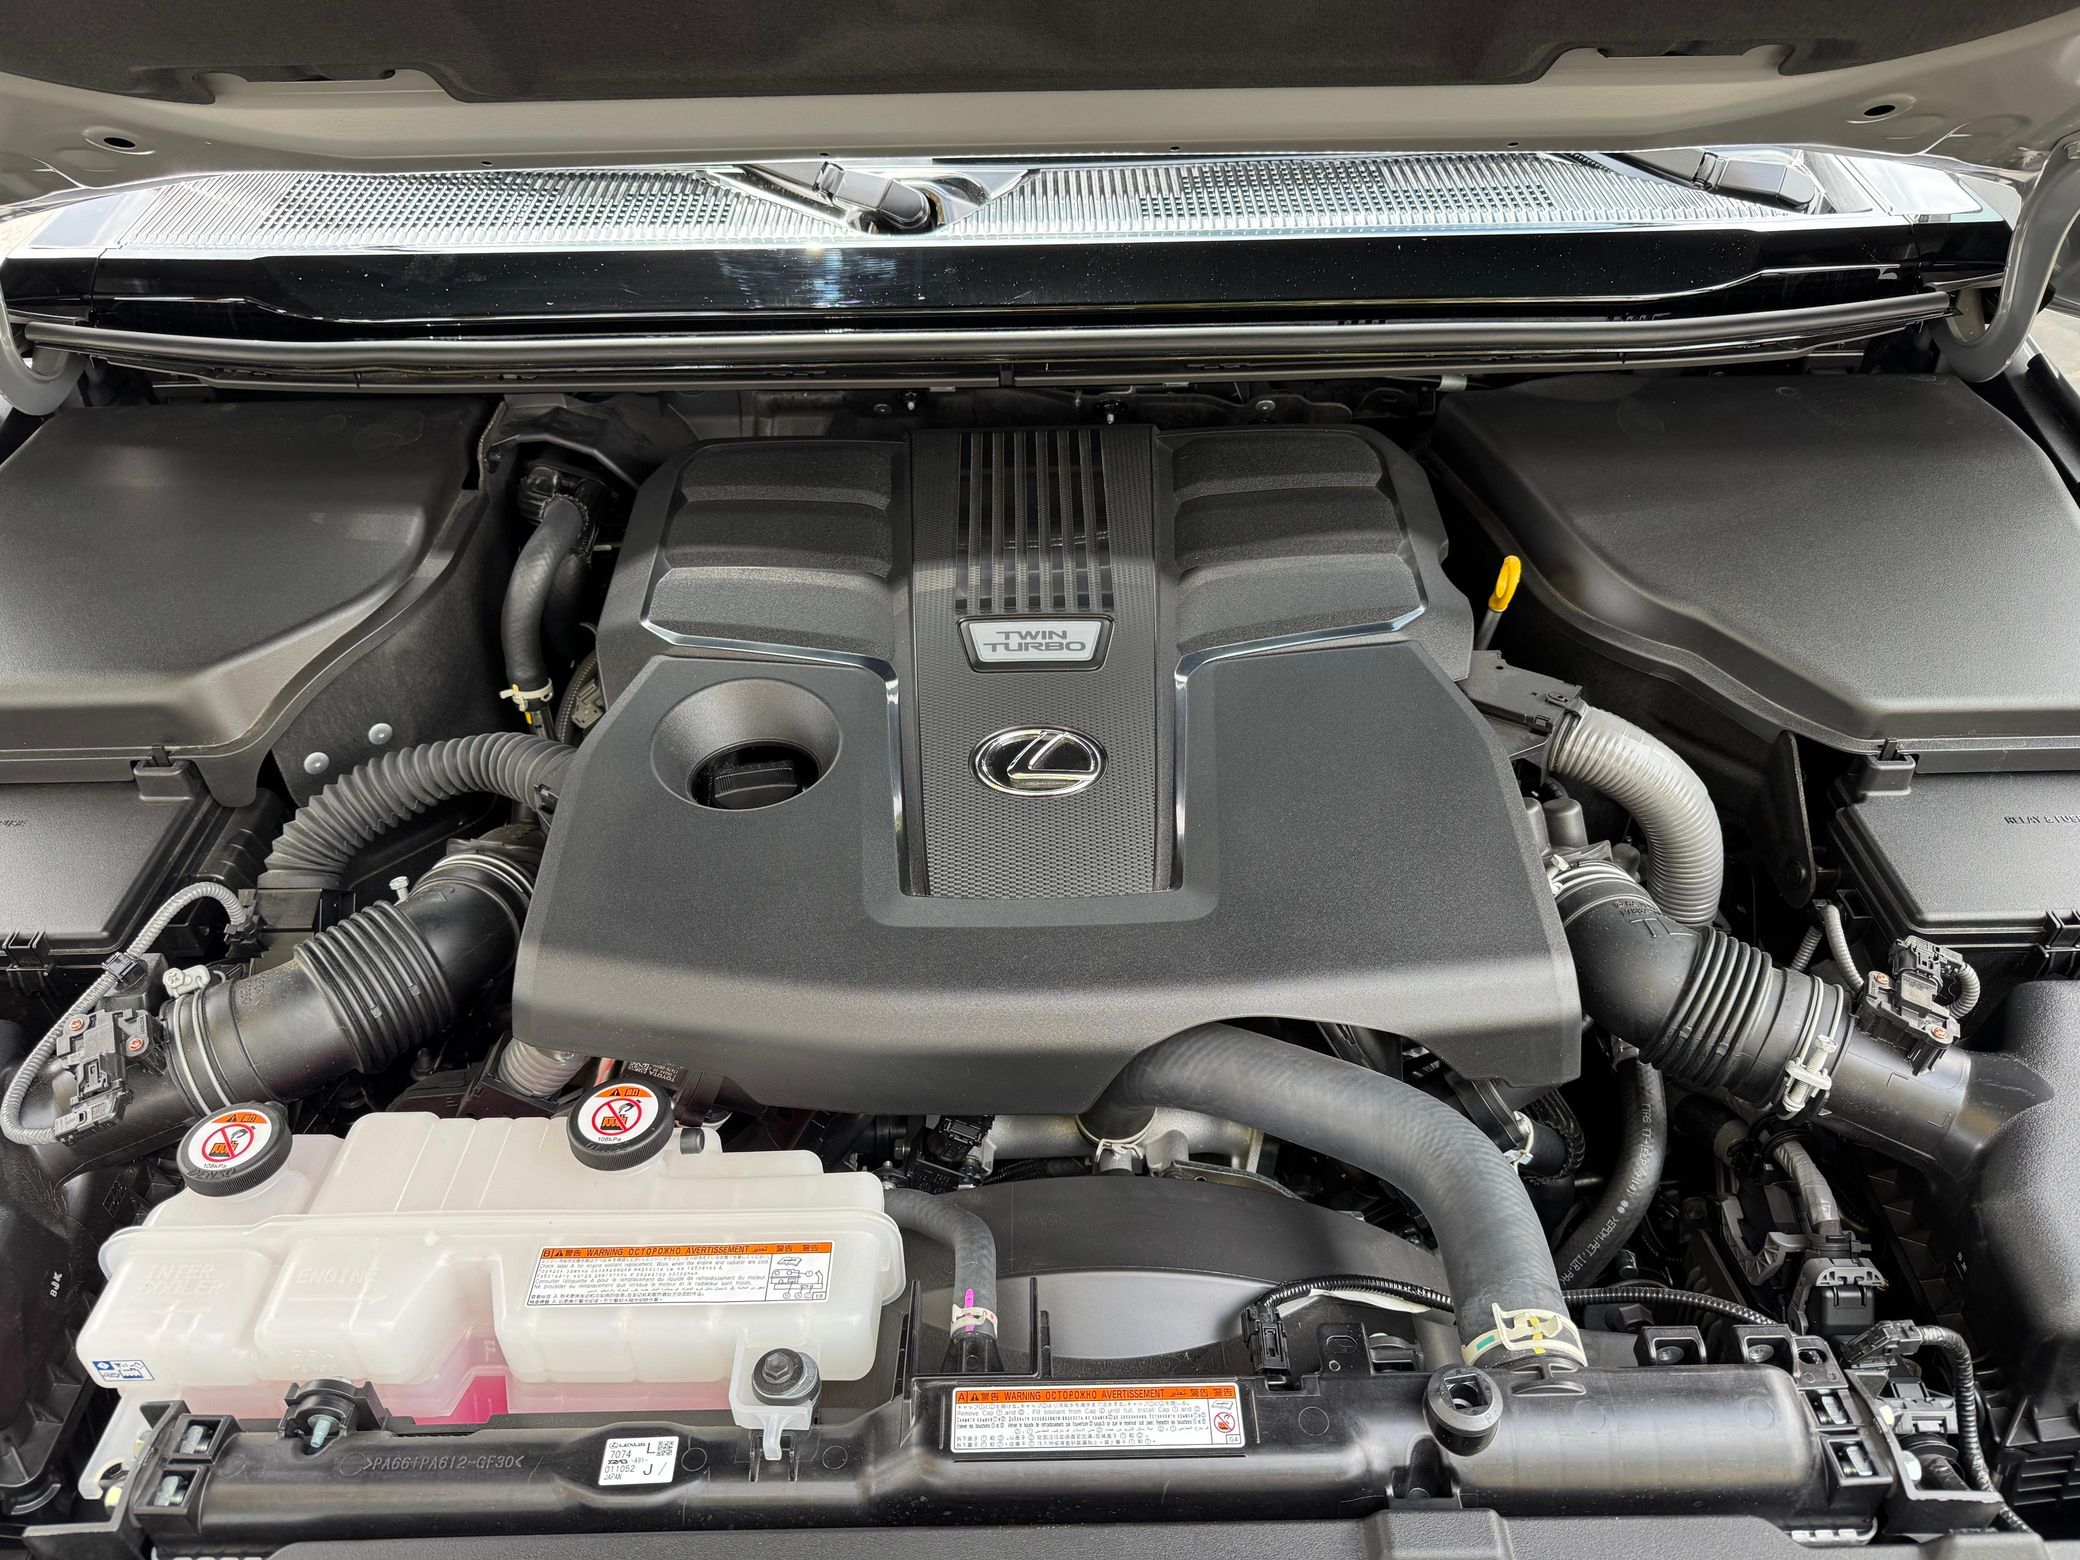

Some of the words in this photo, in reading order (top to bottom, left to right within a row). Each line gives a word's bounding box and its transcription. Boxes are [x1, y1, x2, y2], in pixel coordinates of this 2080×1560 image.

[996, 630, 1068, 640] TWIN
[983, 642, 1086, 652] TURBO
[2004, 816, 2041, 824] RELAY
[649, 1070, 676, 1082] TOYOTA
[187, 1167, 236, 1180] DENSO
[586, 1248, 623, 1257] WARNING
[628, 1246, 680, 1256] ОСТОРОЖНО
[685, 1245, 750, 1255] AVERTISSEMENT
[146, 1263, 216, 1280] INTER
[295, 1267, 380, 1284] ENGINE
[49, 1271, 63, 1298] BJK
[142, 1280, 225, 1296] COOLER
[957, 1392, 966, 1402] A
[1003, 1391, 1041, 1401] WARNING
[1045, 1390, 1097, 1400] ОСТОРОЖНО
[1101, 1388, 1165, 1399] AVERTISSEMENT
[646, 1442, 656, 1454] L
[610, 1450, 632, 1459] 7074
[604, 1464, 636, 1474] 011052
[643, 1463, 653, 1476] J
[604, 1472, 623, 1481] JAPAN
